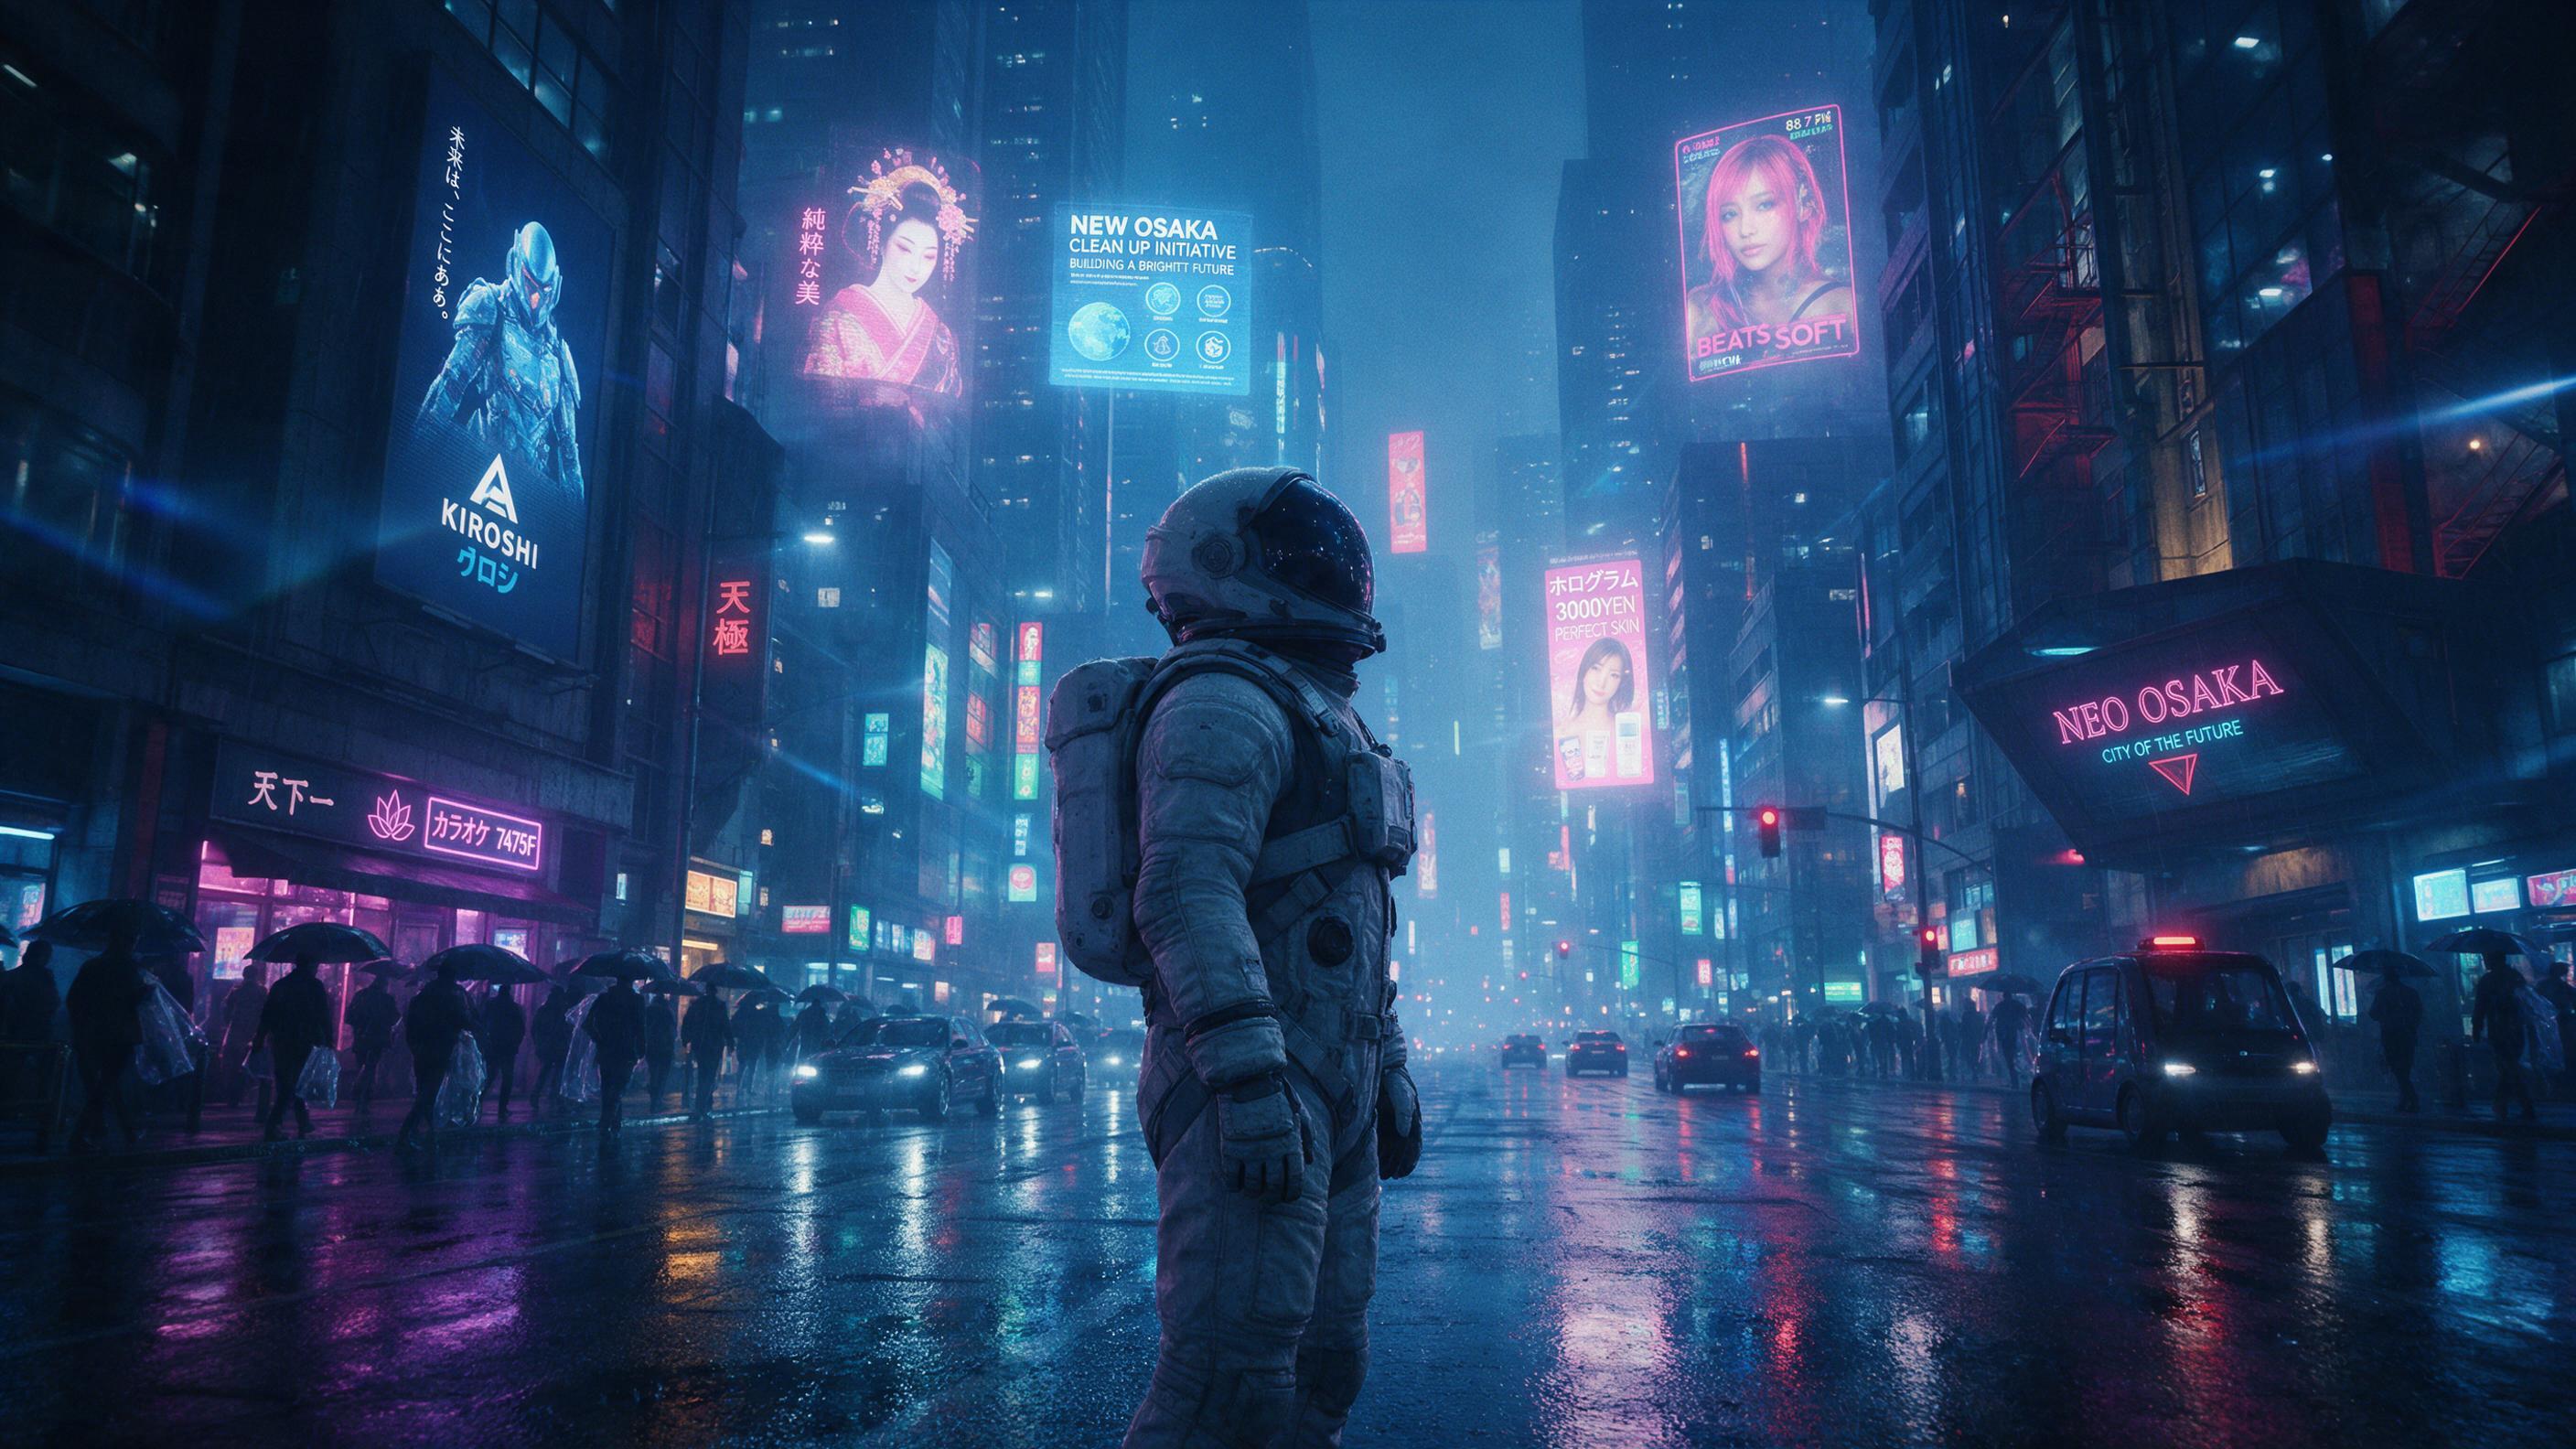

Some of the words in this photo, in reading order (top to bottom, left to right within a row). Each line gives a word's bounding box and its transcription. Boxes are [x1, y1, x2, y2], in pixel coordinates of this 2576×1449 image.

[1069, 238, 1123, 254] CLEAN
[1129, 241, 1151, 255] UP
[1155, 242, 1237, 260] INITIATIVE
[1070, 215, 1128, 235] NEW
[1134, 217, 1218, 241] OSAKA
[795, 207, 826, 306] 純粋な美
[1128, 262, 1136, 271] A
[1192, 263, 1234, 275] FUTURE
[1697, 323, 1771, 358] BEATS
[1775, 319, 1846, 349] SOFT
[441, 498, 538, 570] KIROSHI
[1550, 569, 1638, 596] ホログラム
[713, 581, 751, 656] 天極
[1555, 622, 1607, 642] PERFECT
[1610, 617, 1640, 635] SKIN
[2053, 696, 2130, 745] NEO
[2138, 660, 2284, 724] OSAKA
[2101, 744, 2131, 765] CITY
[2134, 739, 2152, 757] OF
[2154, 734, 2184, 753] THE
[2185, 719, 2243, 746] FUTURE
[248, 770, 334, 816] 天下一
[432, 810, 490, 847] カラオケ
[497, 827, 537, 856] 7475F
